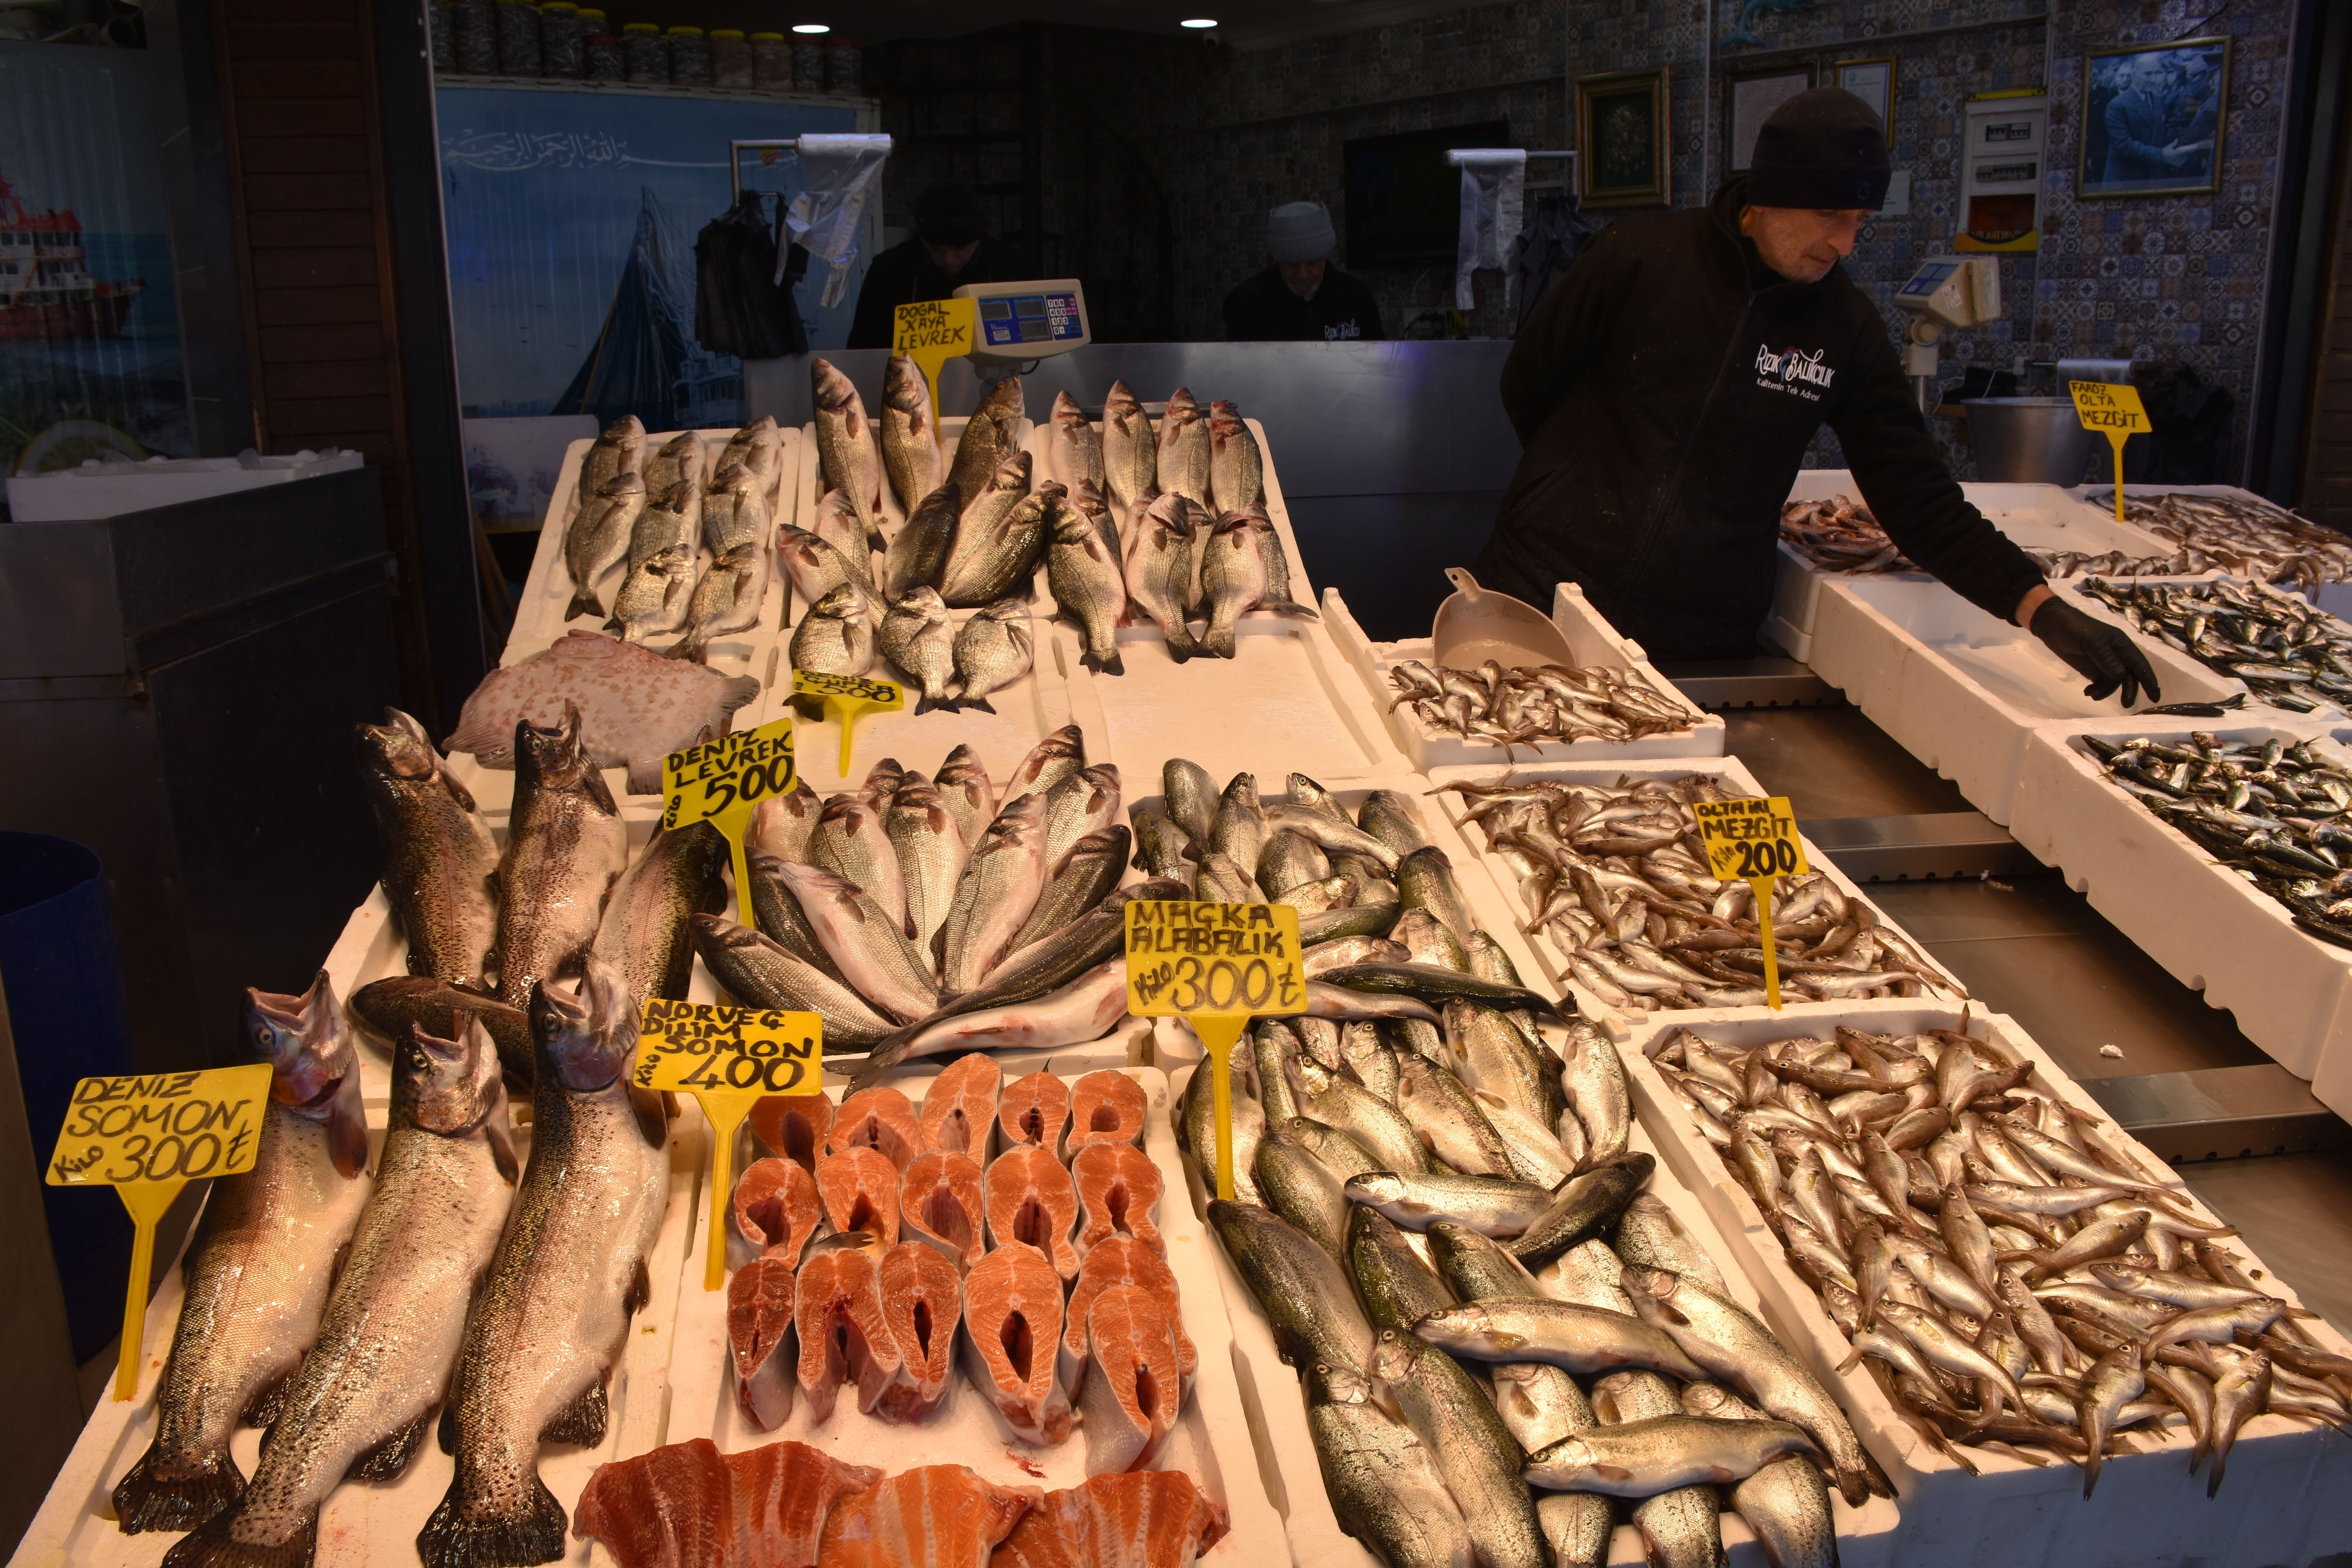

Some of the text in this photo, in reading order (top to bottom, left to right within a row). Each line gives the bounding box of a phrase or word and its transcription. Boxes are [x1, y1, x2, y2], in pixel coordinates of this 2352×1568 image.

[898, 325, 965, 350] LEVREK
[901, 315, 946, 333] KAYA
[1755, 343, 1836, 388] RIZIK BALIKÇILIK
[1757, 377, 1821, 402] Kalitenin Tek Adresi
[2080, 394, 2116, 408] OLTA
[2082, 410, 2140, 428] MEZGİT
[816, 684, 896, 702] 500
[668, 728, 760, 772] DENİZ
[675, 730, 794, 788] LEVREK
[702, 755, 795, 817] 500
[1698, 801, 1745, 817] OLTA
[1703, 812, 1792, 840] MEZGİT
[1735, 838, 1797, 878] 200
[1130, 926, 1285, 958] ALABALIK
[654, 1035, 814, 1059] SOMON
[74, 1071, 201, 1105] DENİZ
[678, 1054, 805, 1092] 400
[66, 1098, 253, 1138] SOMON
